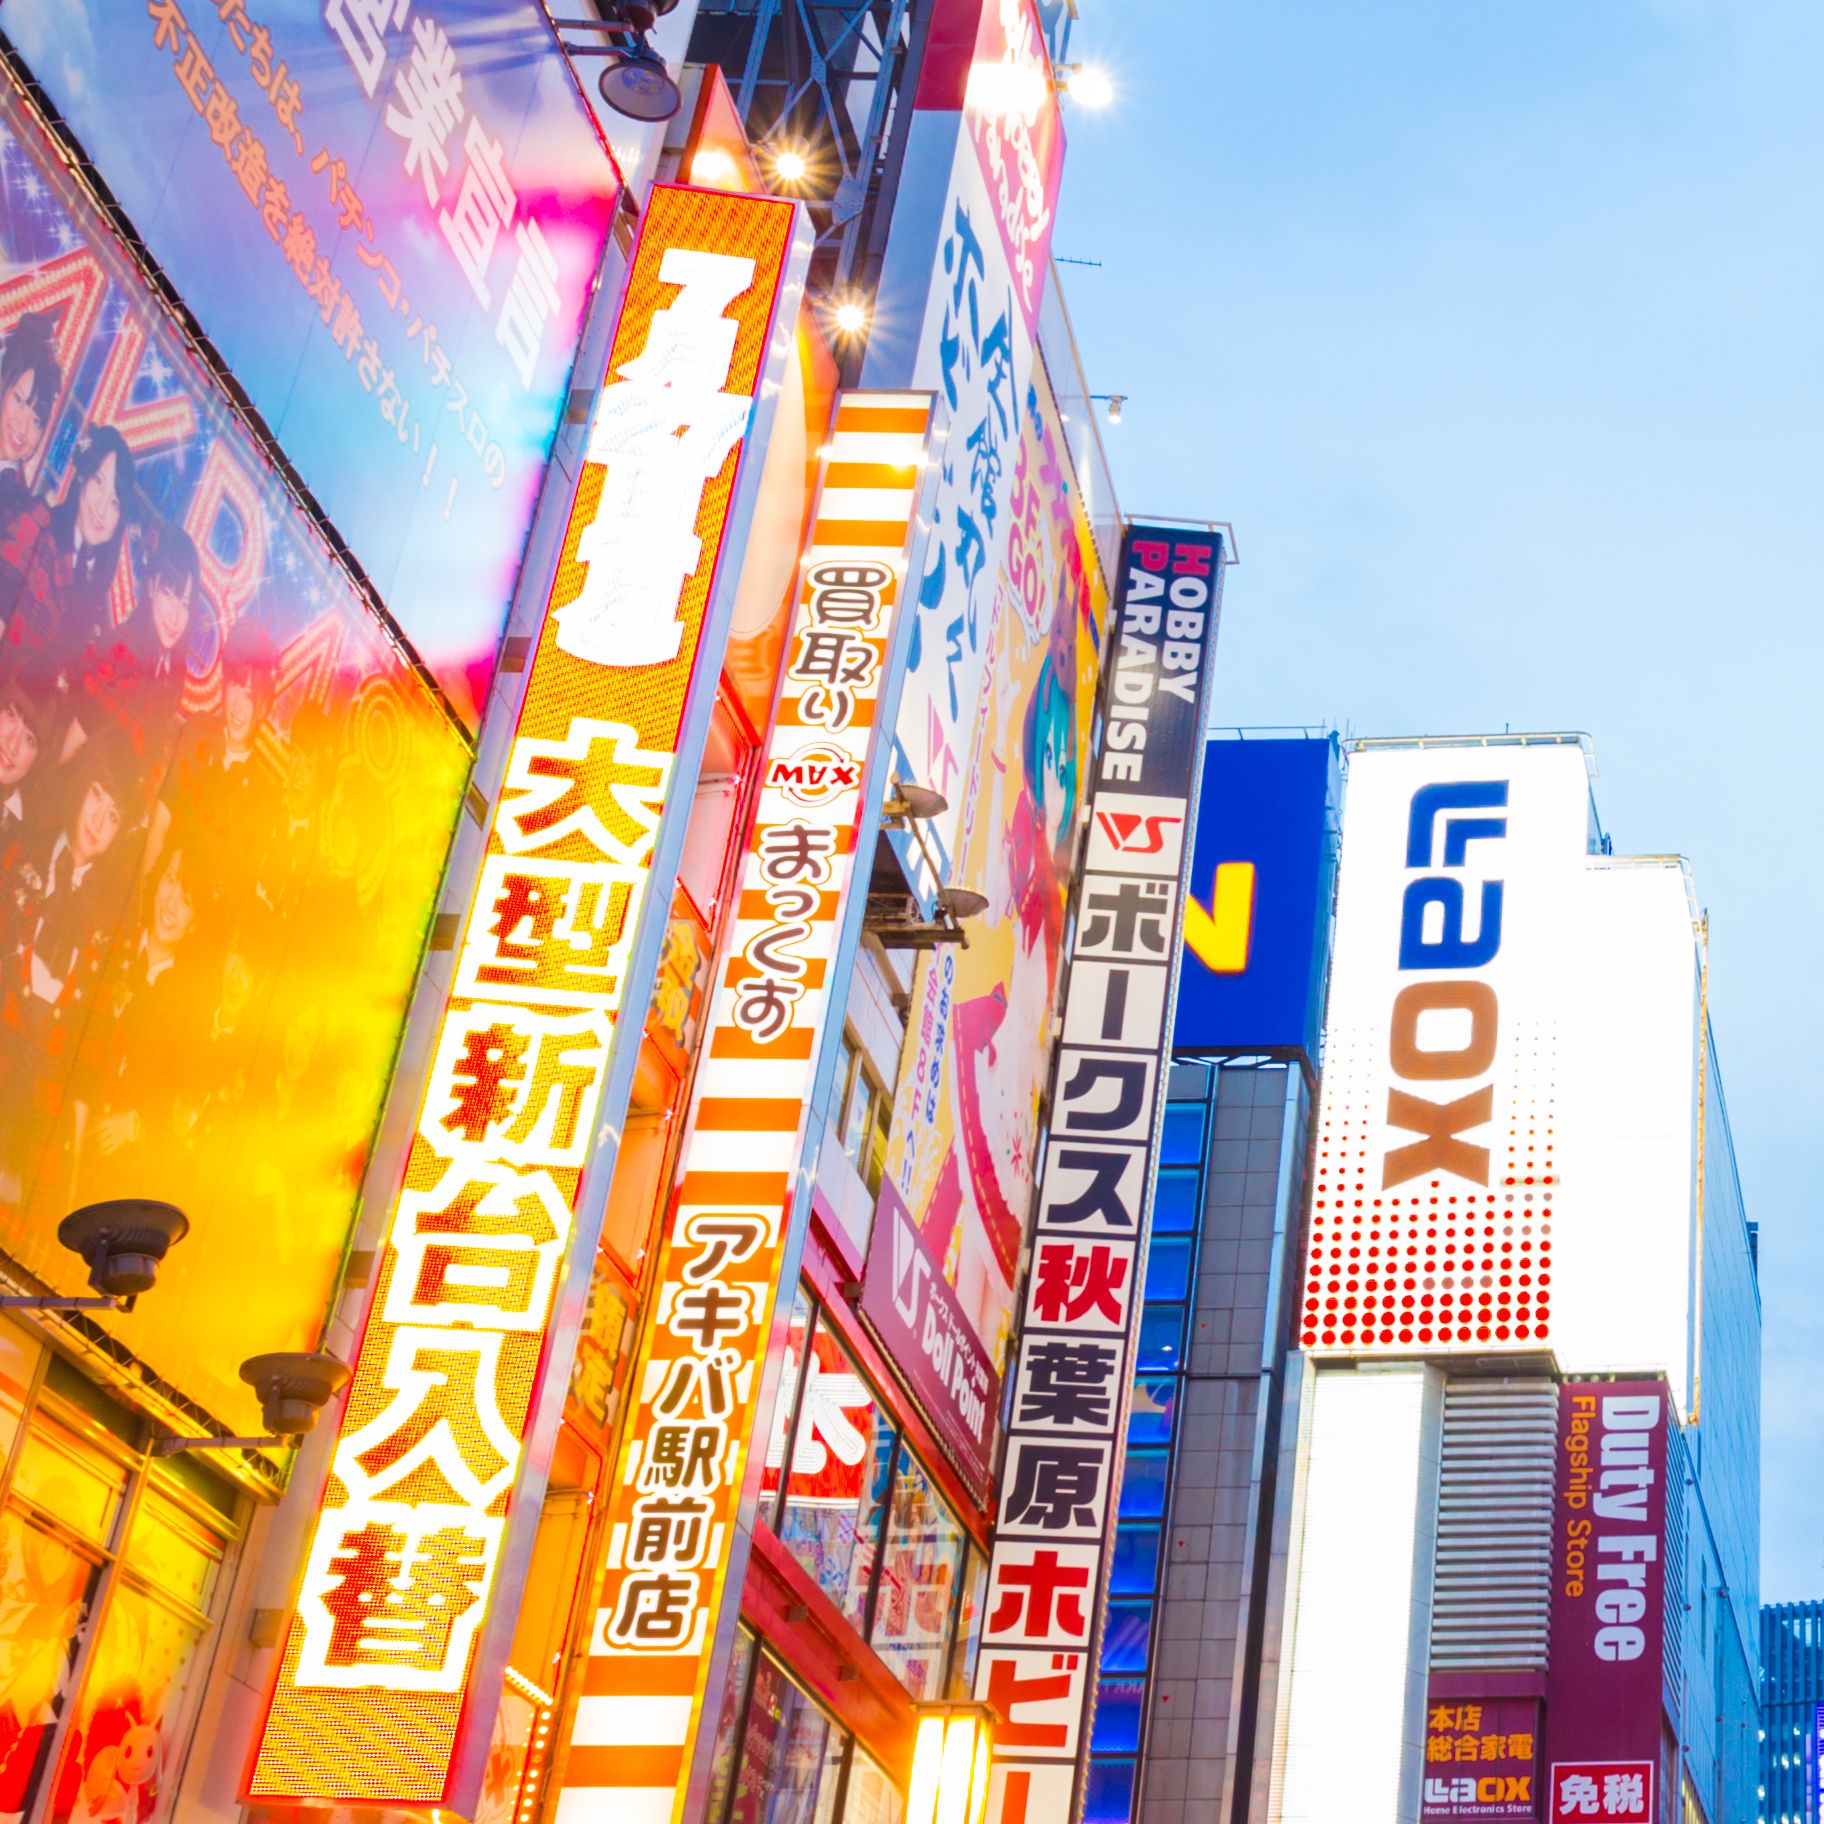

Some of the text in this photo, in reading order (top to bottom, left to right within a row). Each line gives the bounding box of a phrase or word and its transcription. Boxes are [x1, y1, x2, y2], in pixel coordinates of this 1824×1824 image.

[799, 566, 892, 733] 買取り
[1101, 540, 1170, 783] PARADISE
[1158, 543, 1212, 703] HOBBY
[738, 826, 836, 1044] まっくす
[302, 721, 674, 1690] 大型新台入替
[614, 1220, 758, 1644] アキバ駅前店
[920, 1311, 987, 1446] Doll Point
[1563, 1394, 1597, 1599] Flagship Store
[1592, 1394, 1661, 1662] Duty Free
[1426, 1734, 1534, 1762] 総合家電
[1428, 1706, 1483, 1732] 本店
[1558, 1774, 1644, 1816] 免税
[1423, 1804, 1533, 1815] Home Electronics Store
